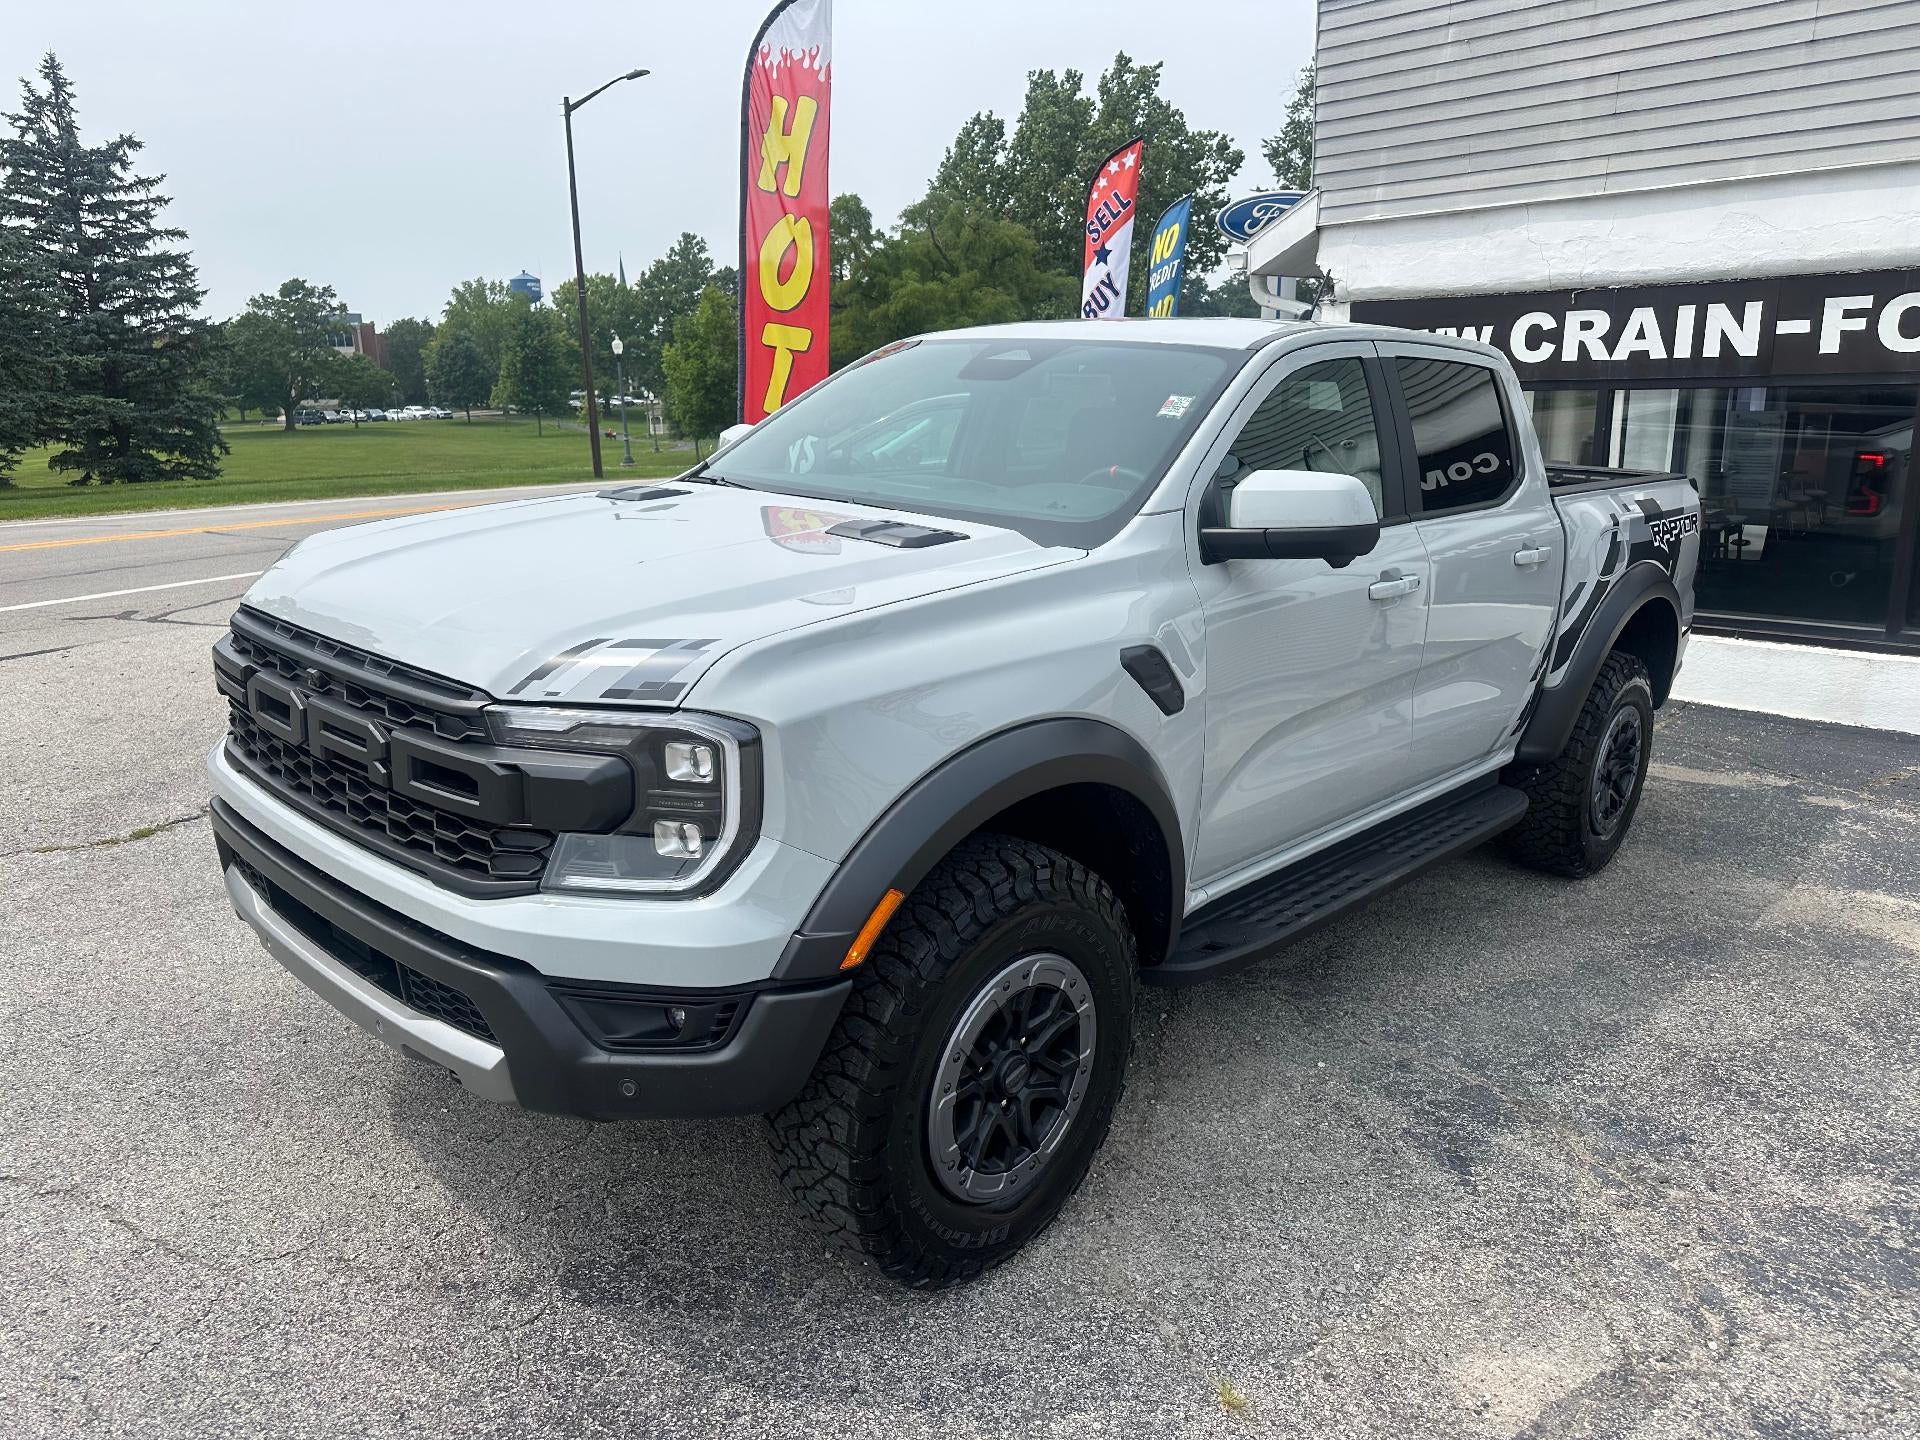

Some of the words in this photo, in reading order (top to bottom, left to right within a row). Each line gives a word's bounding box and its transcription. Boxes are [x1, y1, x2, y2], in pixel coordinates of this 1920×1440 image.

[1086, 190, 1132, 243] SELL
[757, 95, 818, 415] HOT
[1150, 223, 1180, 269] NO
[1082, 271, 1120, 319] BUY
[1149, 259, 1181, 292] REDIT
[1648, 512, 1699, 553] RAPTOR
